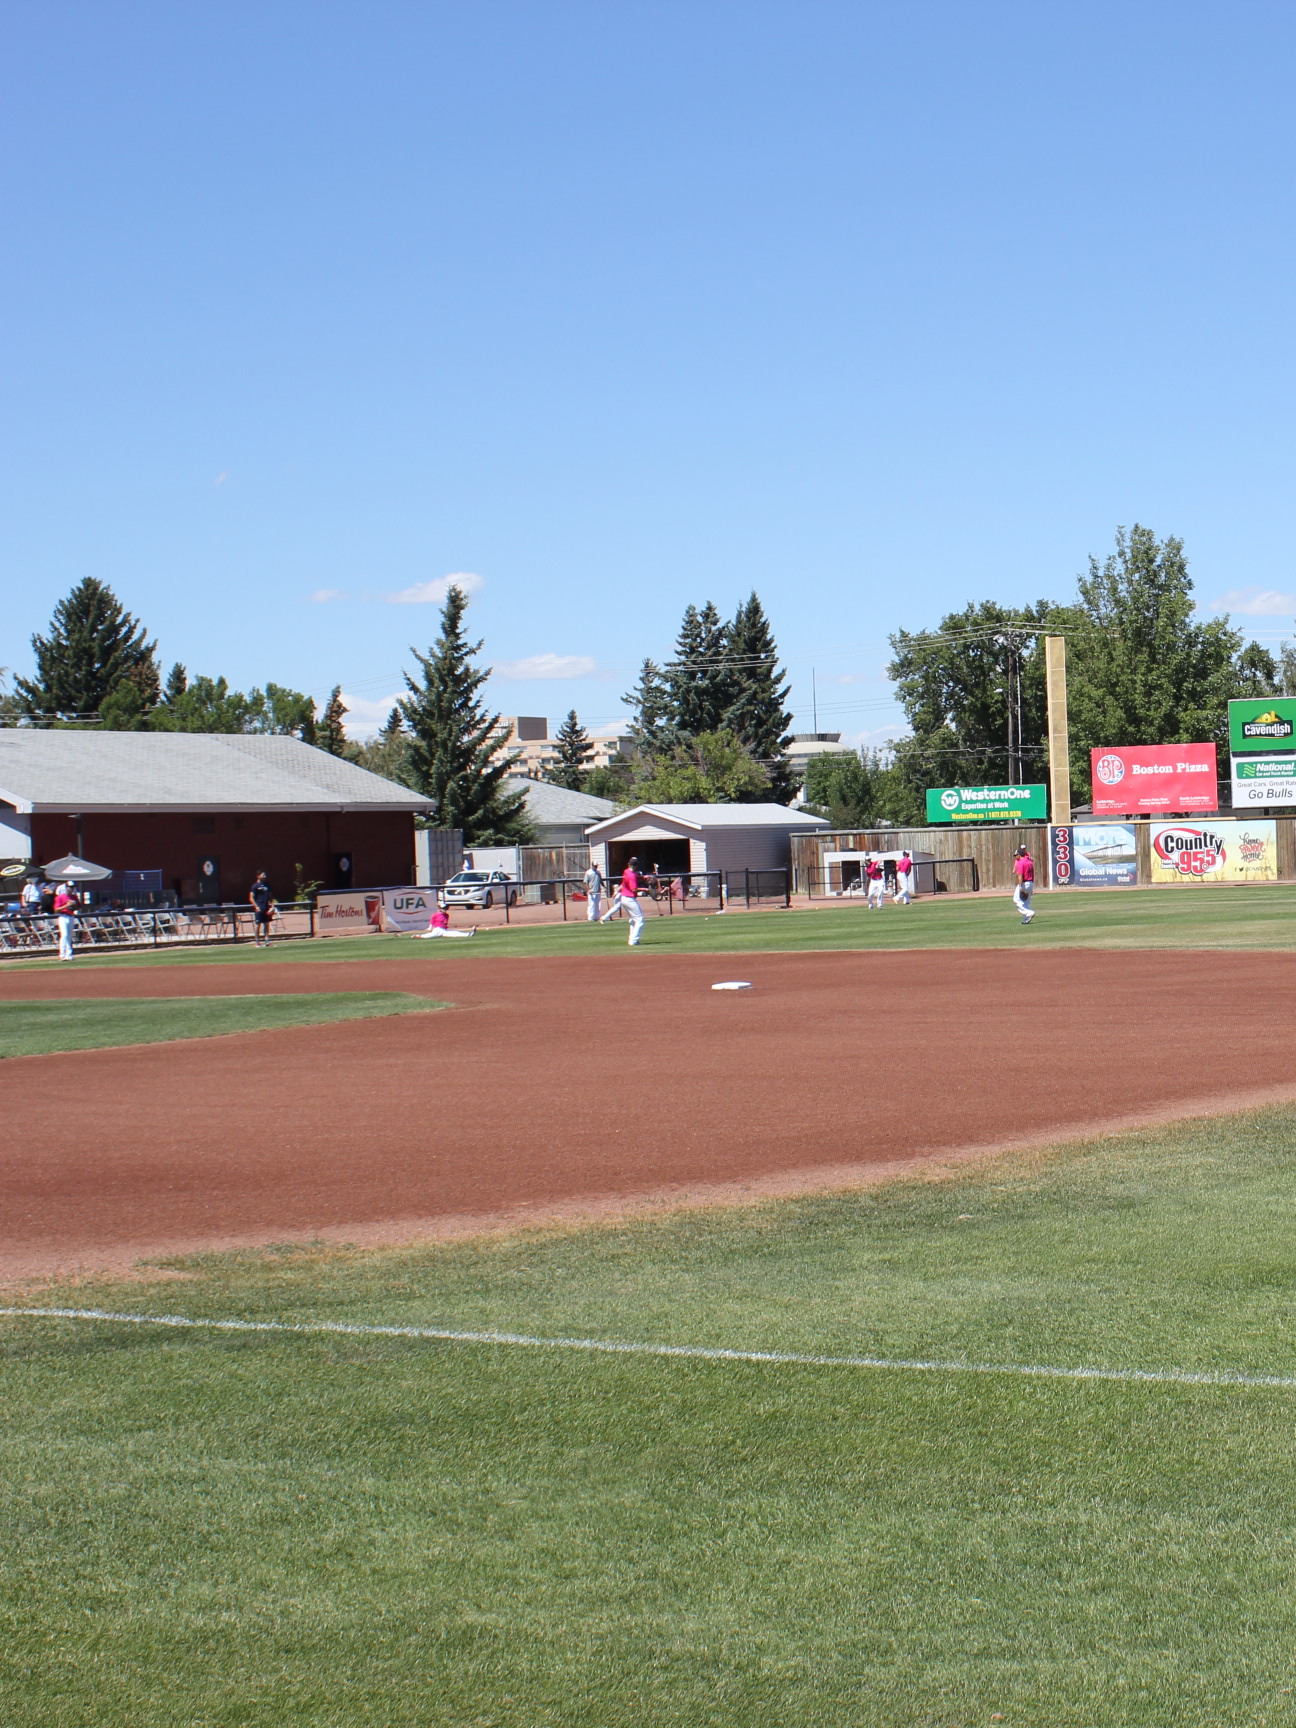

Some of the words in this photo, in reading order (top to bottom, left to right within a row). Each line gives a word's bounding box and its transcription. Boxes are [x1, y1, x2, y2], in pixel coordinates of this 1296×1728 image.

[1244, 723, 1290, 735] Cavendish
[1132, 764, 1173, 775] Boston
[1176, 762, 1209, 773] Pizza
[960, 788, 1031, 800] WesternOne
[1248, 789, 1264, 799] Go
[1266, 788, 1293, 799] Bulls
[962, 802, 986, 810] Expertise
[1164, 831, 1224, 856] Country
[1056, 828, 1070, 878] 330
[1080, 868, 1104, 876] Global
[1106, 867, 1128, 875] News
[393, 896, 427, 910] UFA
[320, 905, 334, 919] Tim
[335, 904, 364, 918] Hortons
